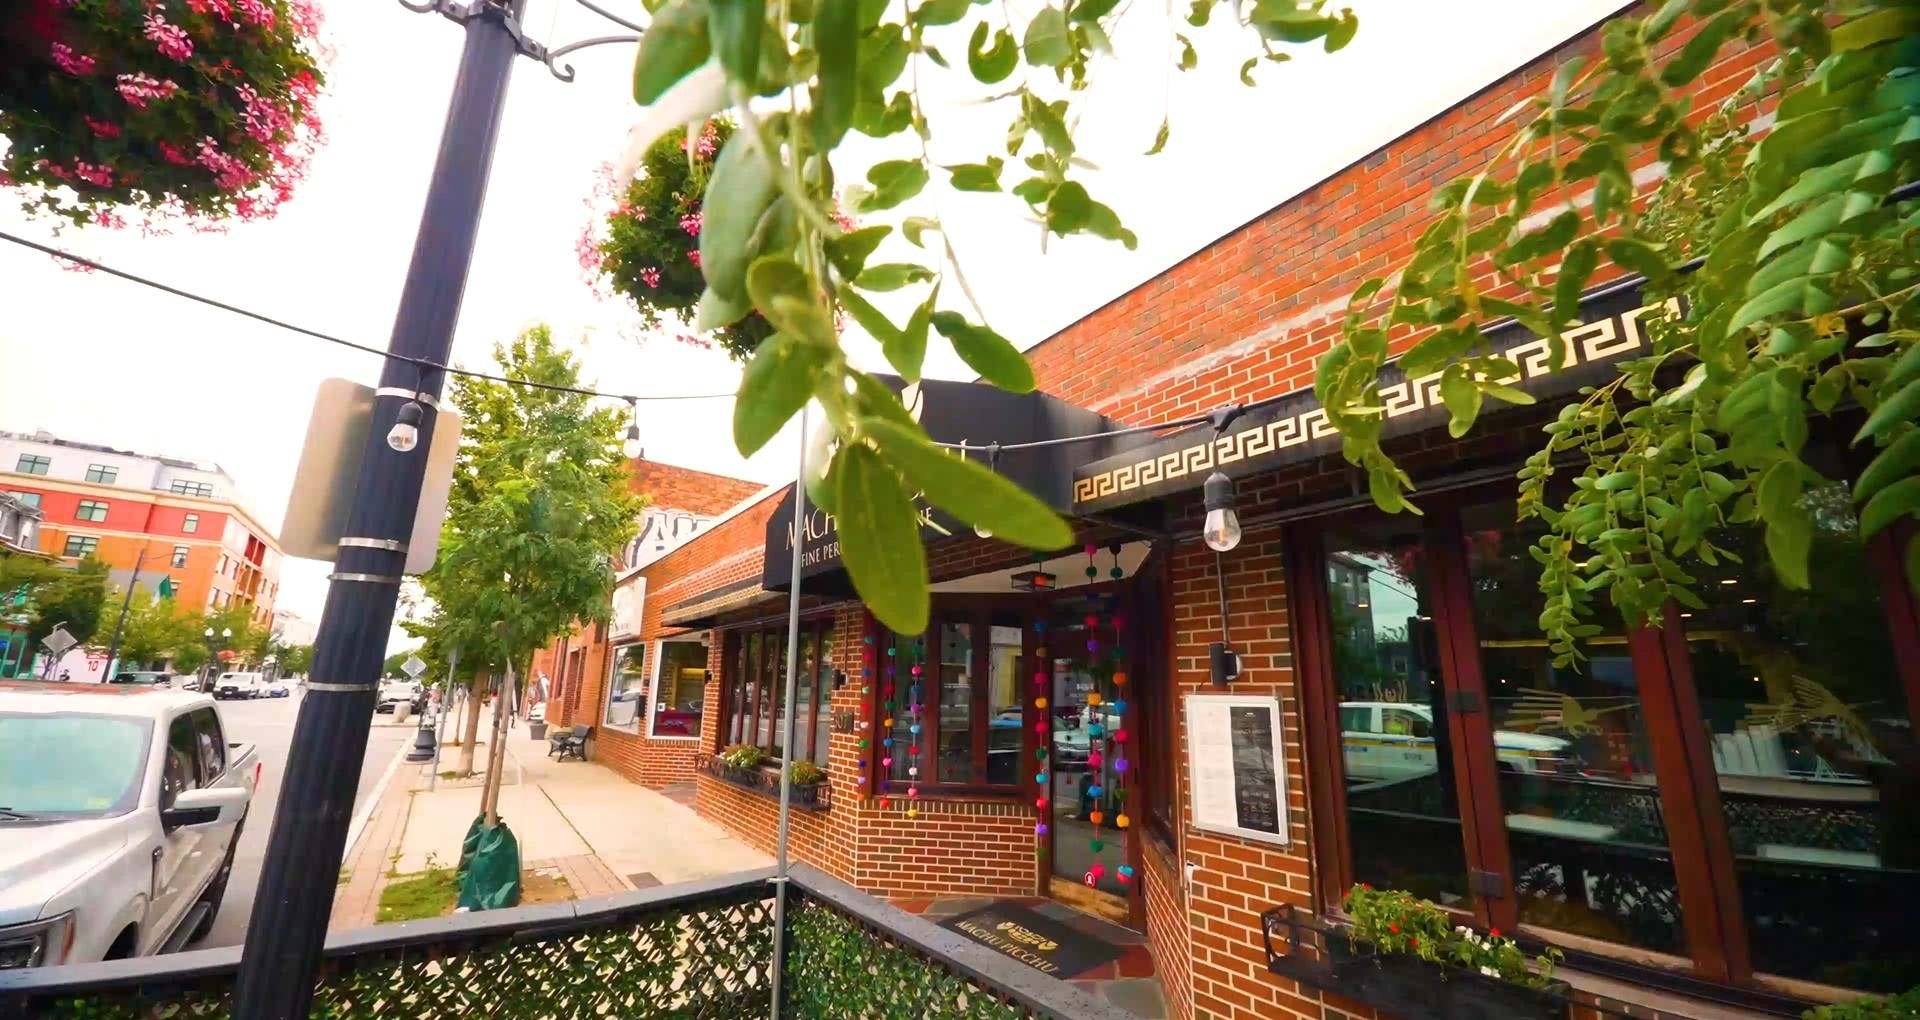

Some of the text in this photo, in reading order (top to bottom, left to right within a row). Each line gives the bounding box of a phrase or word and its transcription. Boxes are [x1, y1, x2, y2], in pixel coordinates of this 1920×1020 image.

[785, 507, 839, 551] MACH
[801, 540, 843, 568] FINE PER
[954, 920, 1060, 973] MACHU PICCHU
